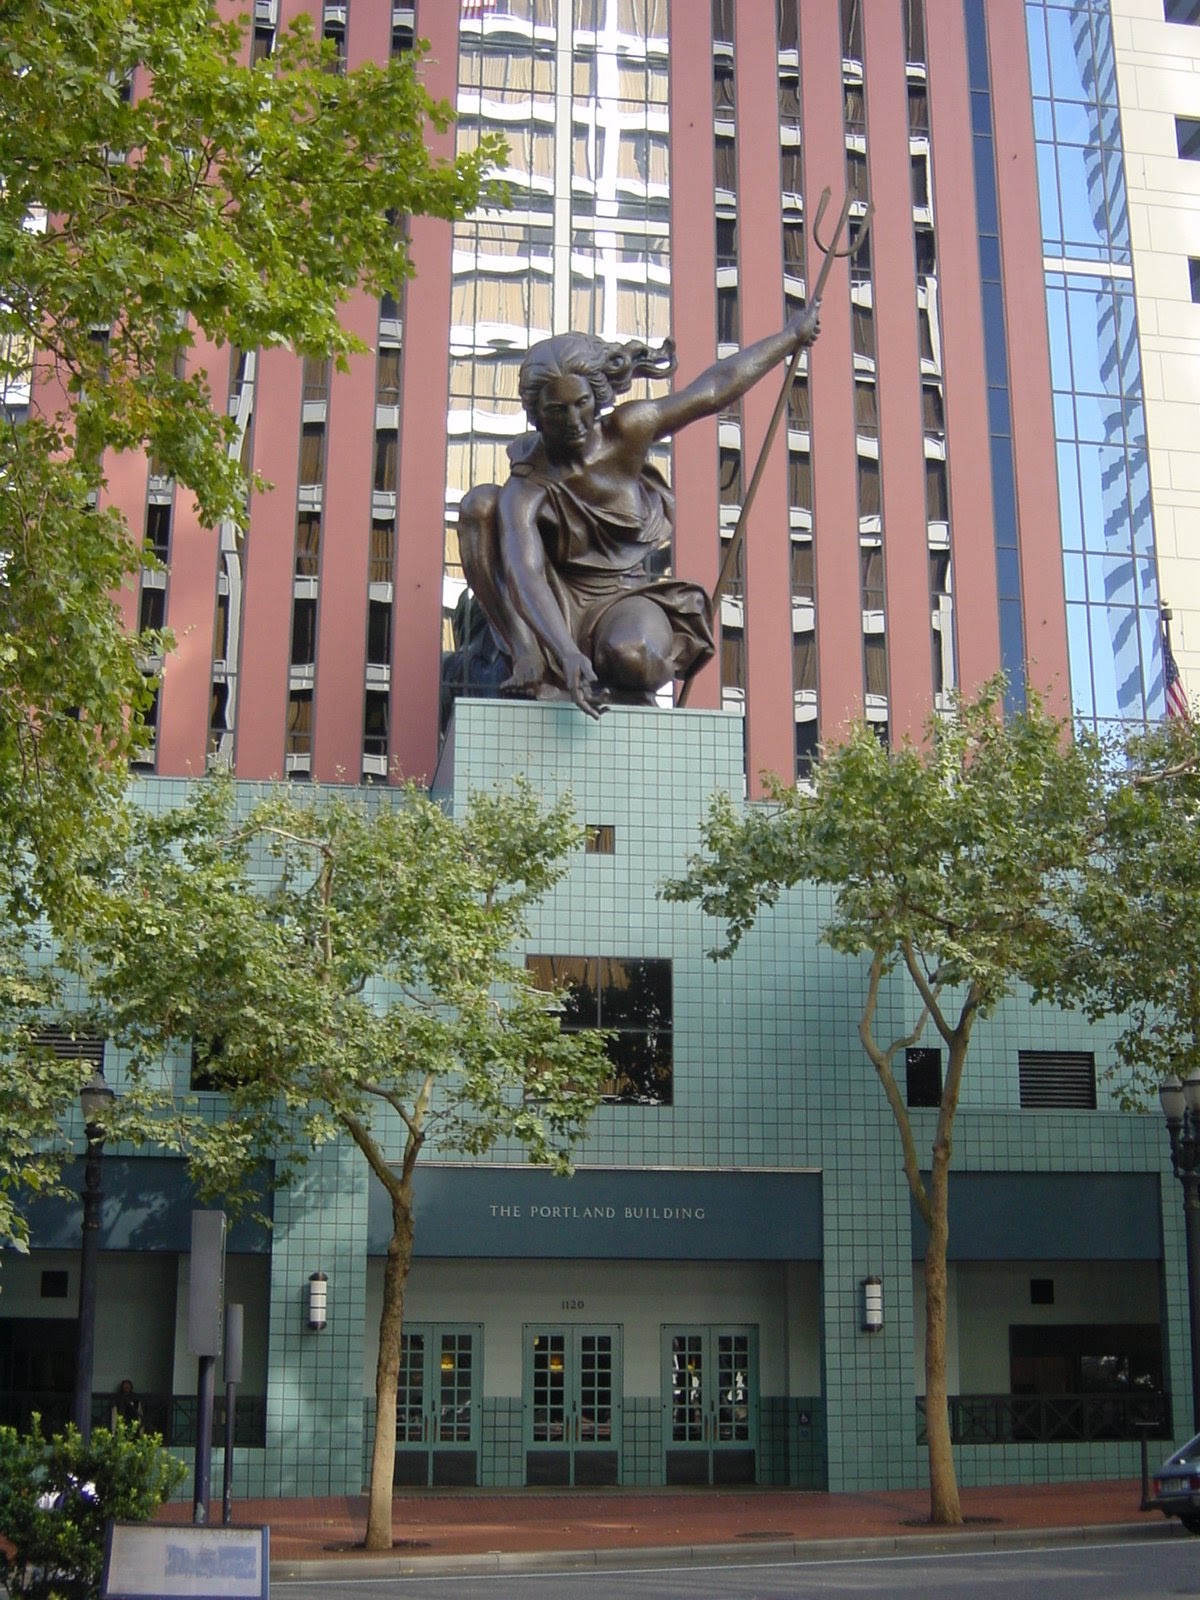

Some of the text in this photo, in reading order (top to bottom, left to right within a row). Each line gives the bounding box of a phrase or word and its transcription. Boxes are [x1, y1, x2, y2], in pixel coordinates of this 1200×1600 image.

[490, 1205, 705, 1220] THE PORTLAND BUILDING
[562, 1300, 585, 1310] 1120
